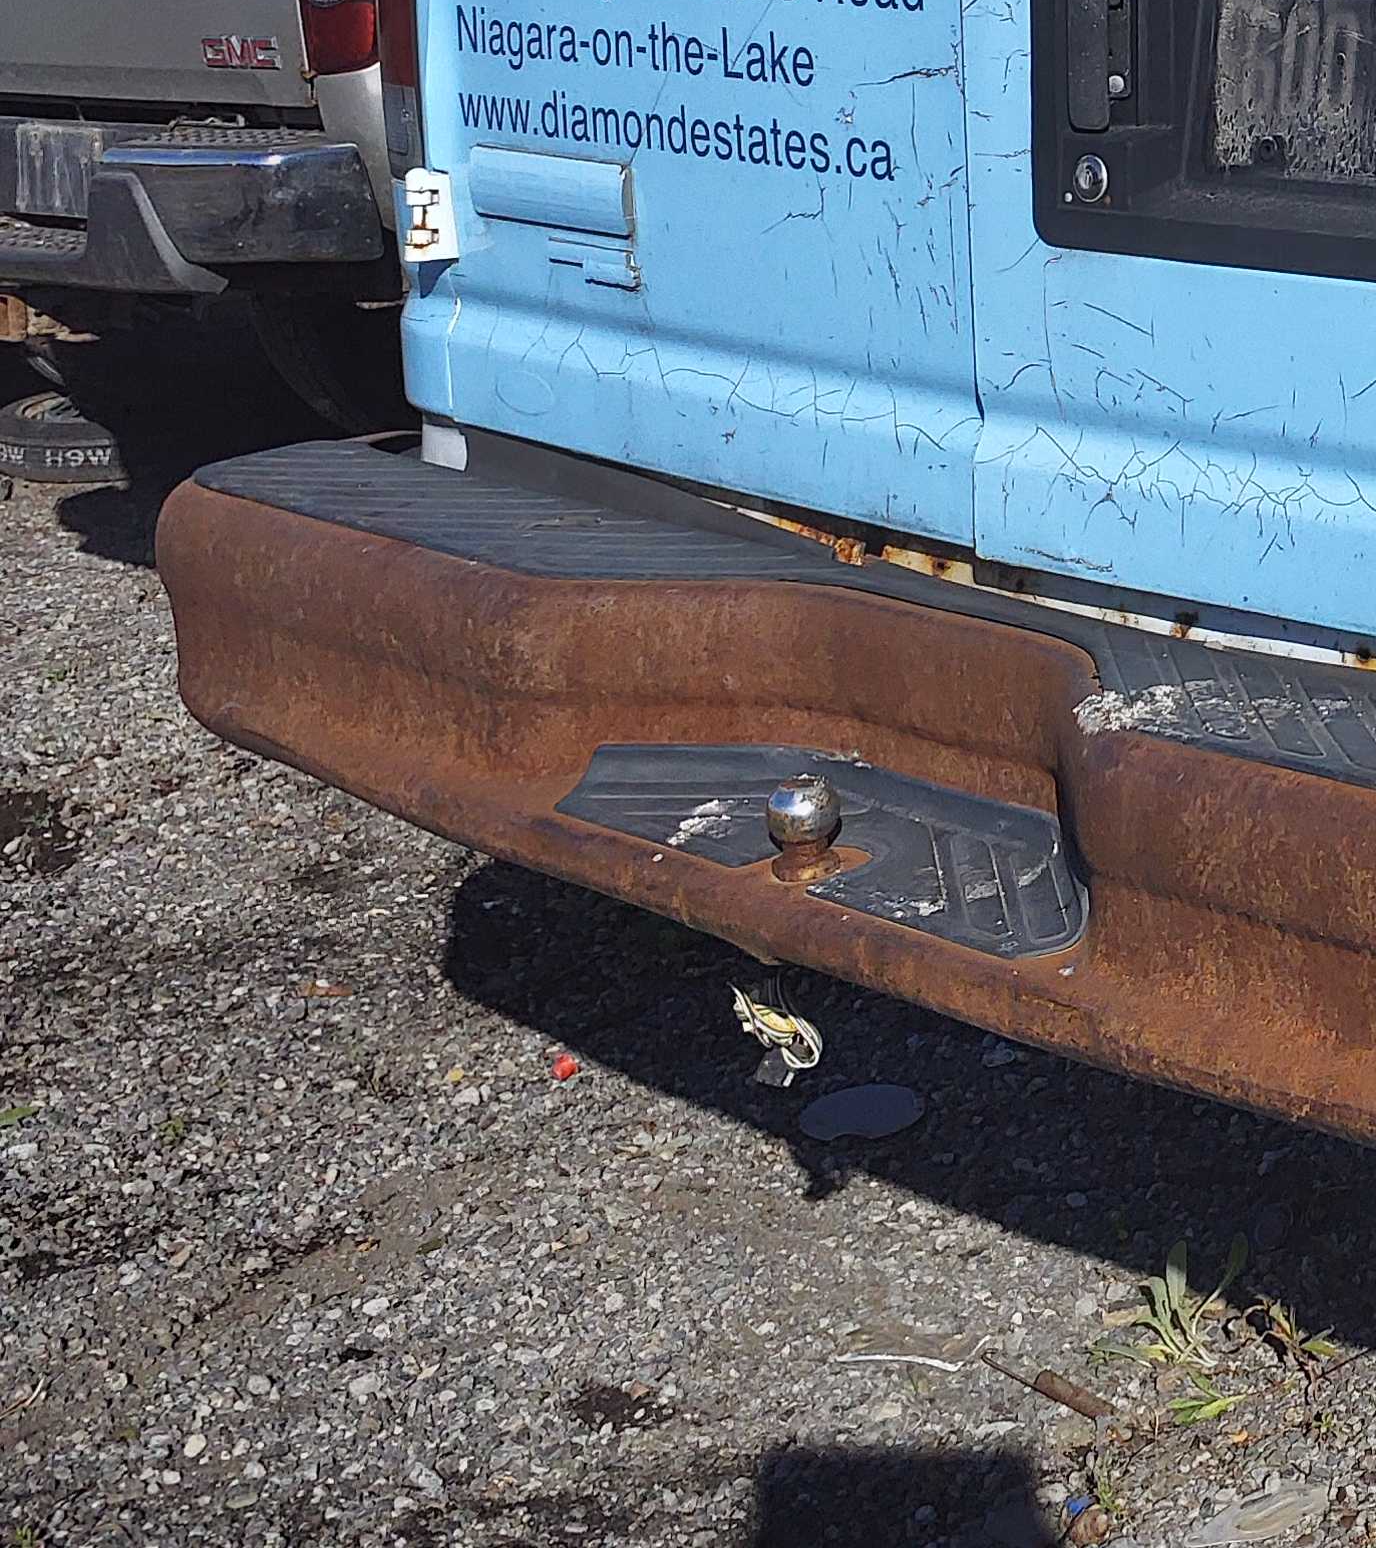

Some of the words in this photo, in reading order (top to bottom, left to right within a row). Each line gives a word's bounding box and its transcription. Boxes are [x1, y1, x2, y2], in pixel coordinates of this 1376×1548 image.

[201, 35, 281, 70] GMC
[456, 4, 815, 87] Niagara-on-the-Lake
[458, 90, 898, 181] www.diamondestates.ca
